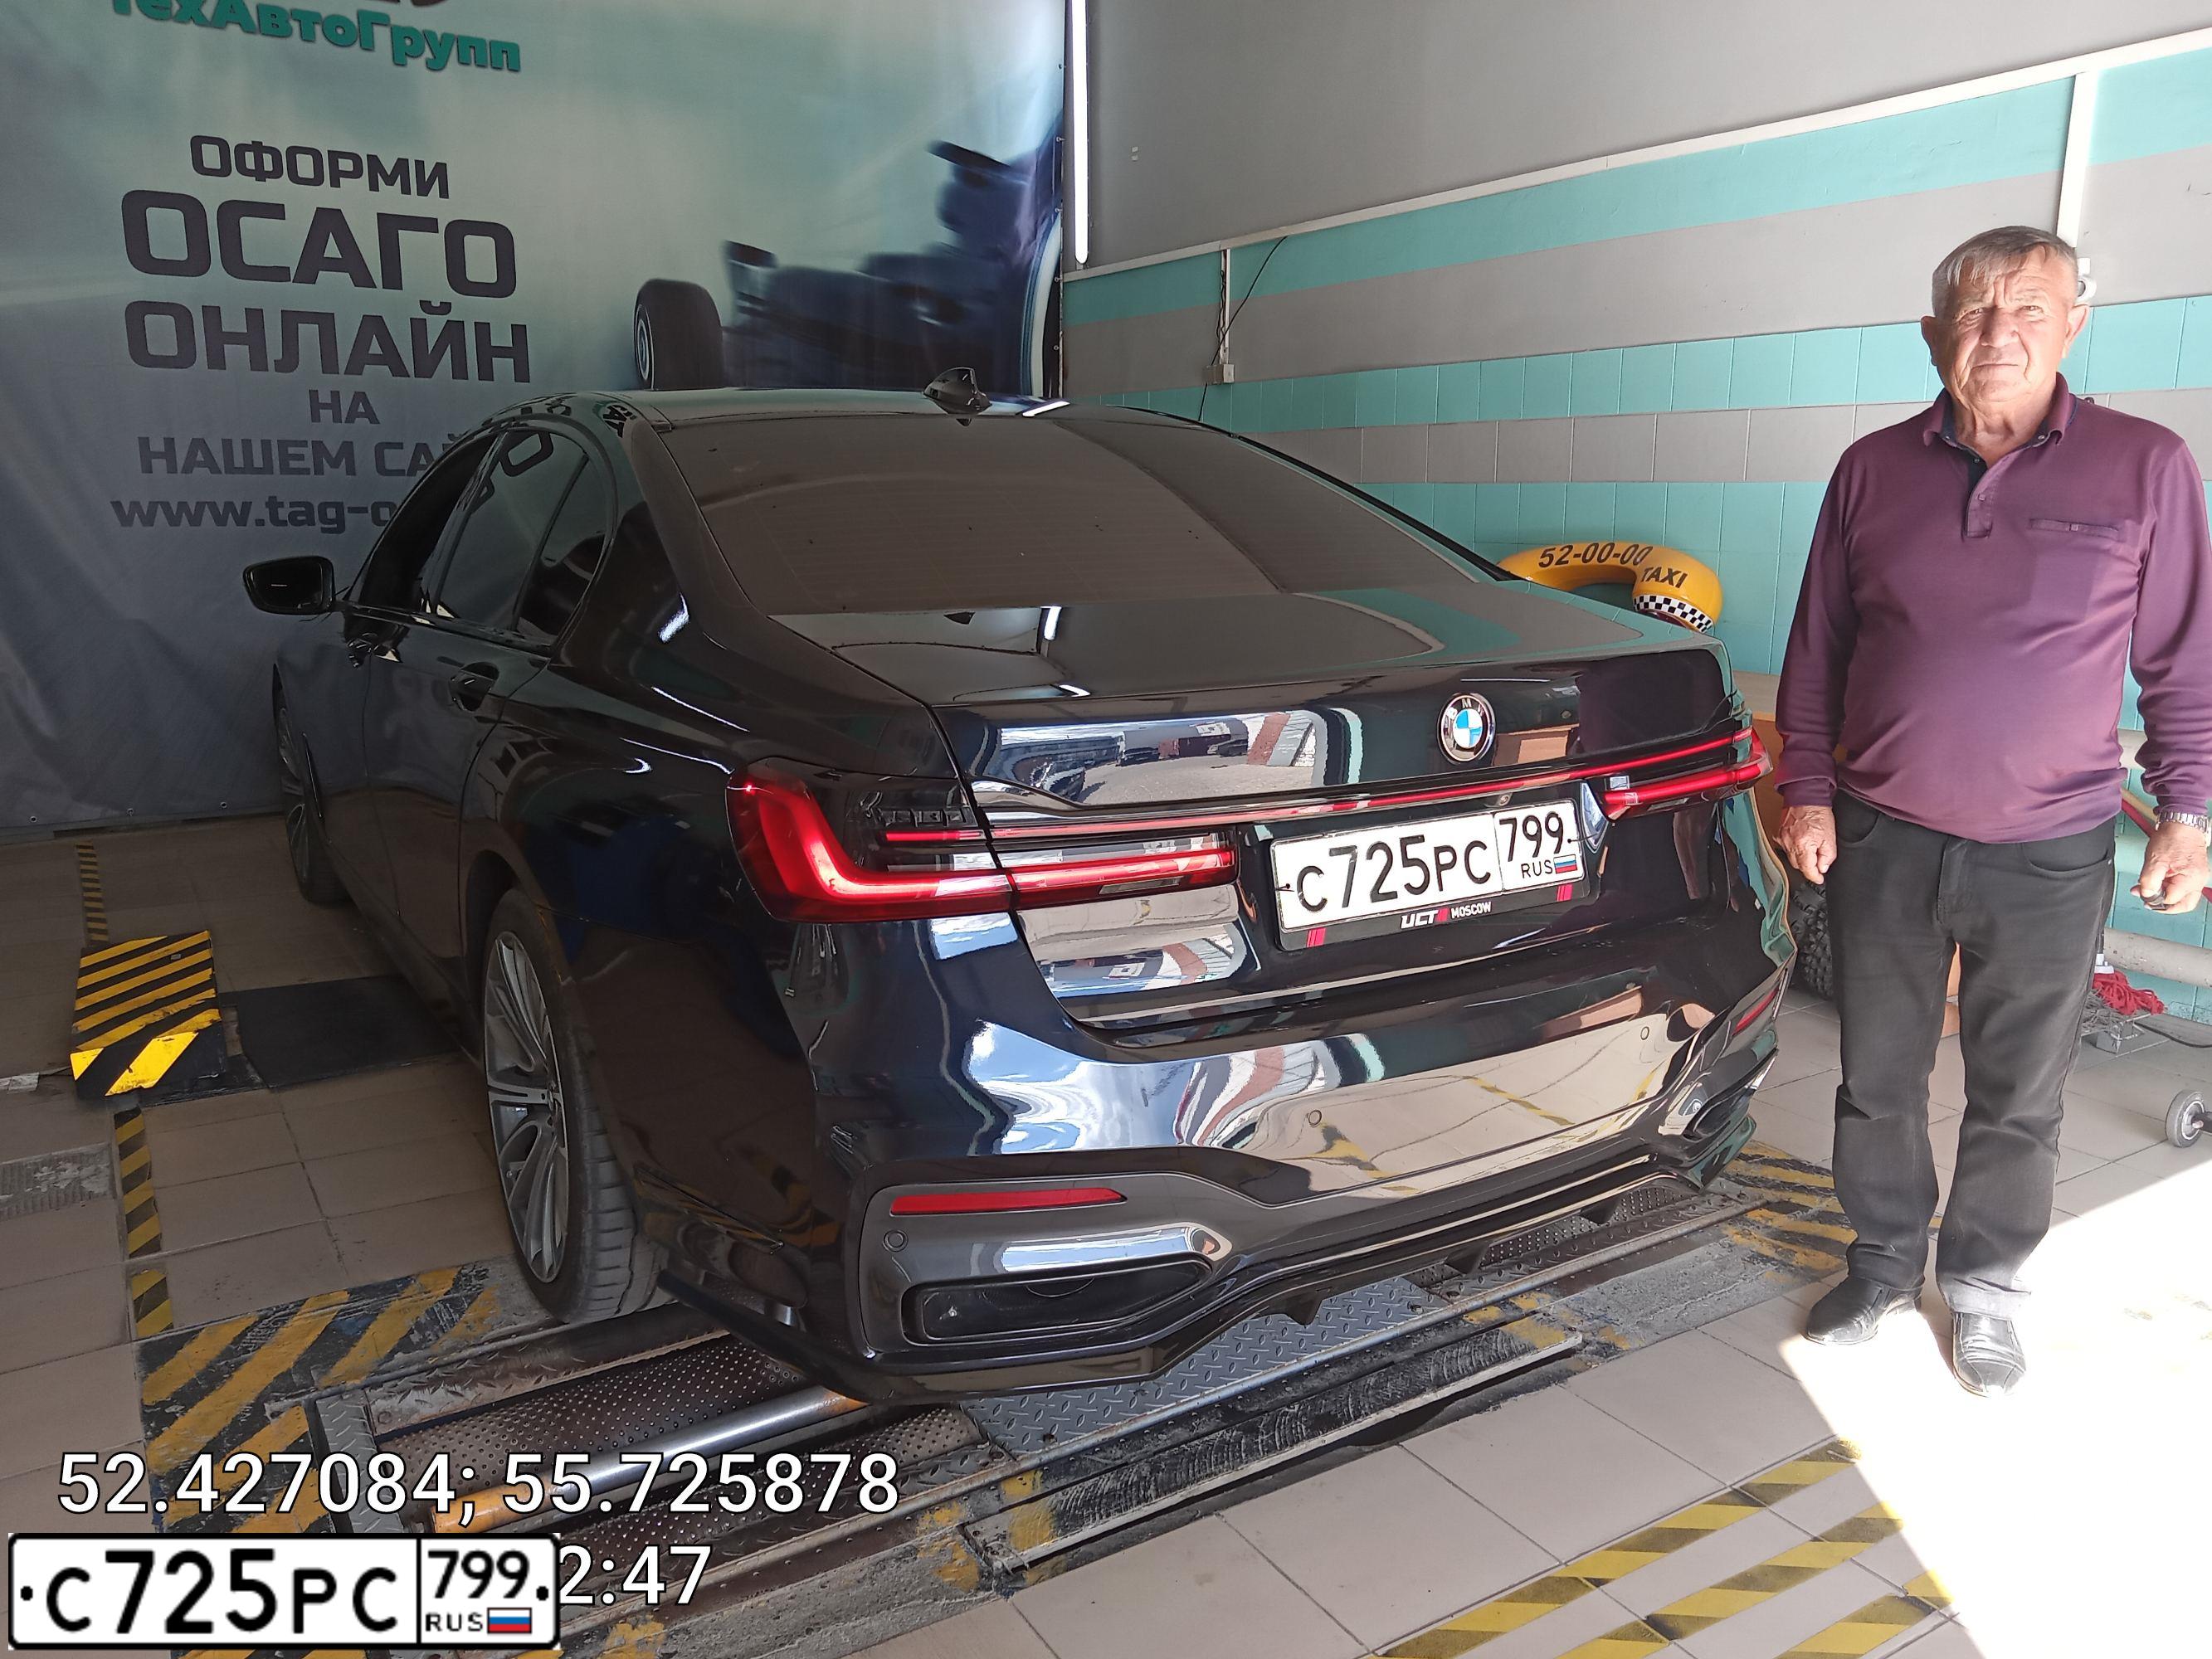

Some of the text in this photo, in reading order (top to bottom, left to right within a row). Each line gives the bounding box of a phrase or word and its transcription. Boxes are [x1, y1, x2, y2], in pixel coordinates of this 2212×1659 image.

[189, 135, 450, 199] ОФОРМИ
[121, 189, 517, 299] ОСАГО
[124, 299, 531, 383] ОНЛАЙН
[308, 389, 381, 425] НА
[137, 433, 465, 477] НАШЕМ СА
[1538, 542, 1654, 568] 52-00-00
[1640, 566, 1688, 589] TAXI
[1296, 810, 1565, 913] С725РС 799
[1521, 861, 1554, 879] RUS
[1450, 901, 1492, 920] MOSCOW
